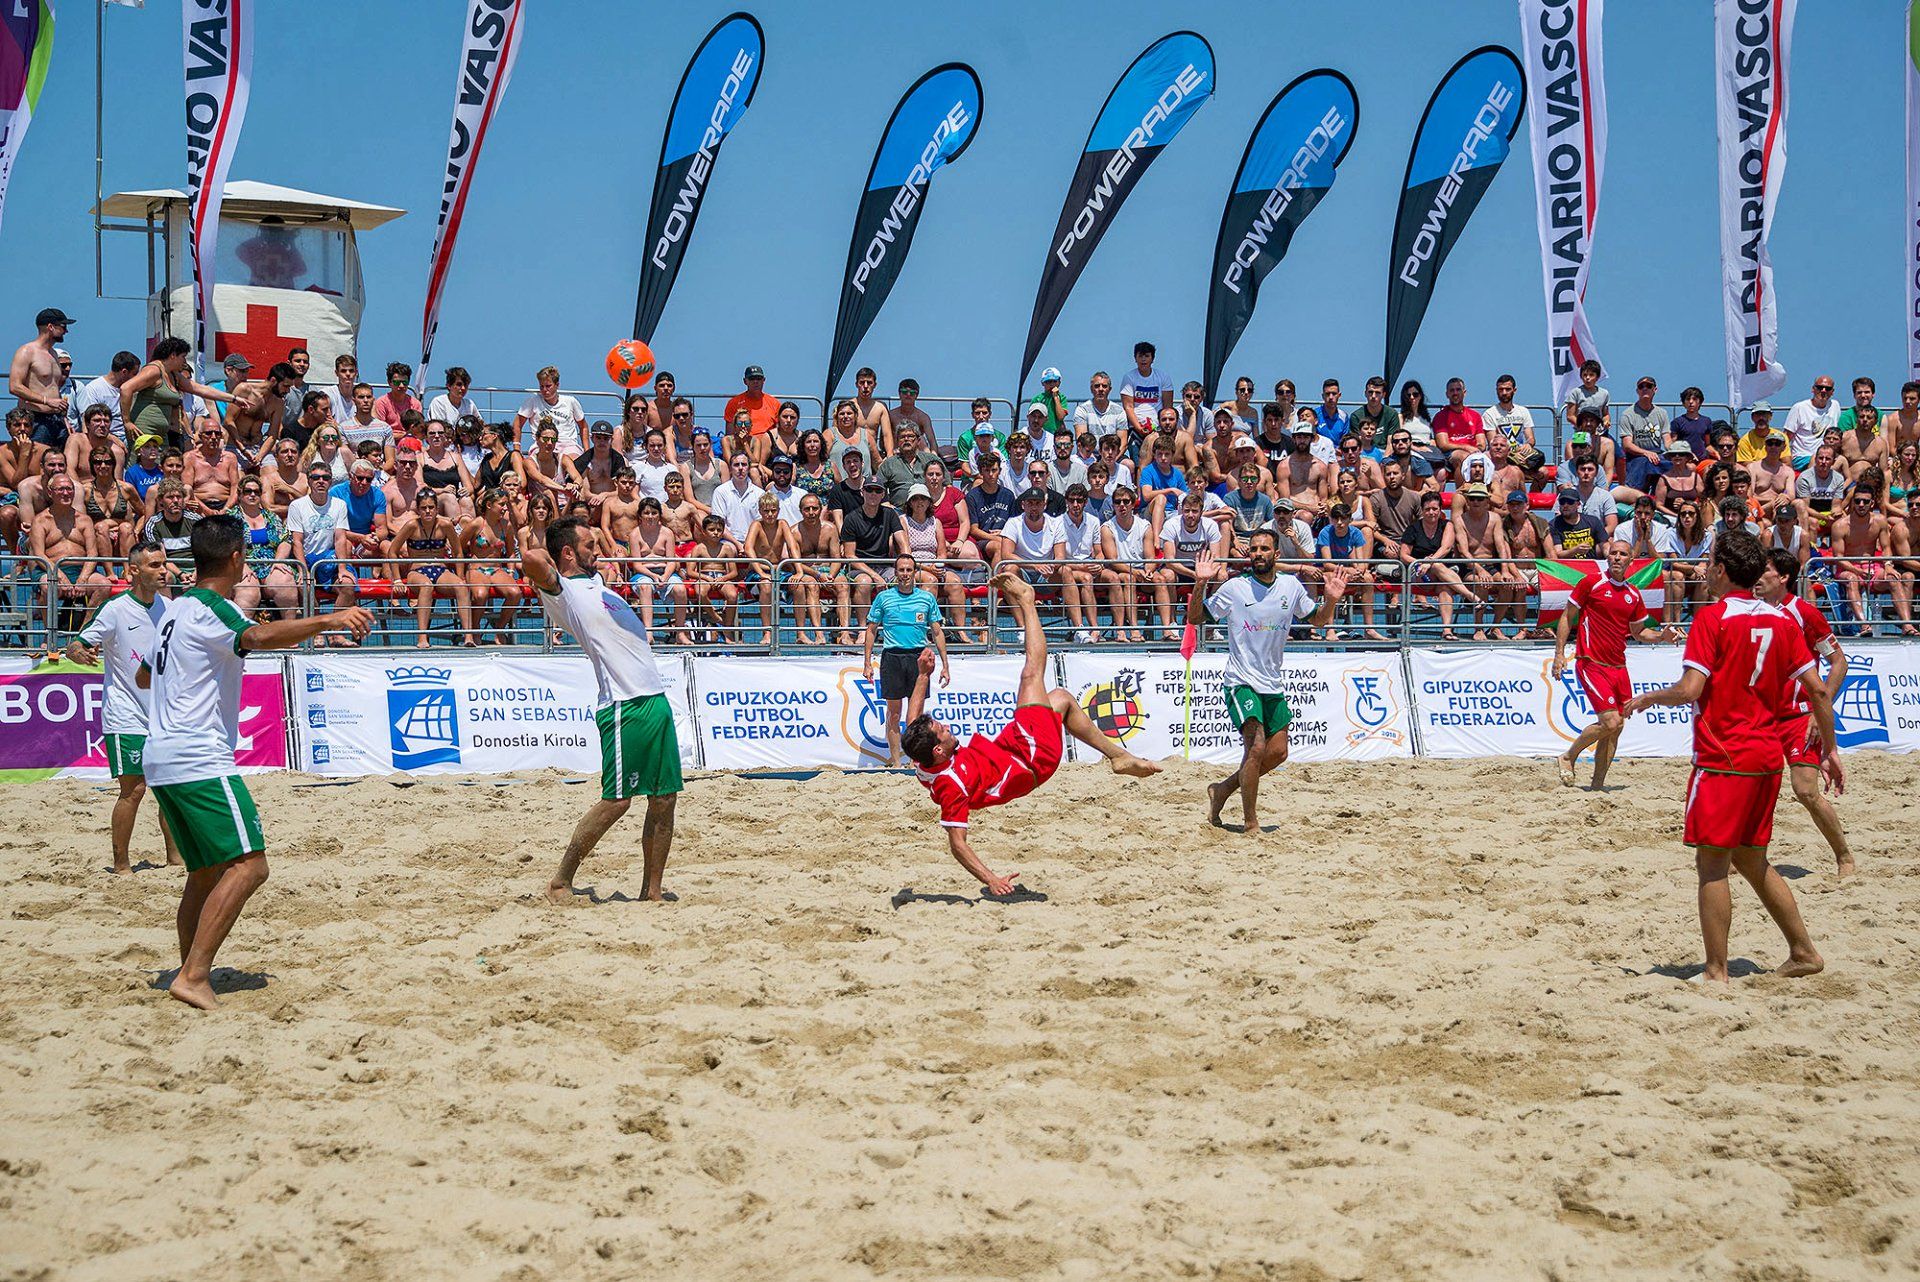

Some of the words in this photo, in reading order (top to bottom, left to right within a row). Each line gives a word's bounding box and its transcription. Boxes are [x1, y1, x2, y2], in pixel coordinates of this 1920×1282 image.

[1540, 0, 1580, 138] VASC
[652, 48, 753, 270] POWERADE
[1057, 63, 1204, 267] POWERADE
[1400, 80, 1513, 287] POWERADE
[852, 100, 970, 294] POWERADE
[1223, 105, 1345, 294] POWERADE
[1548, 143, 1585, 313] DIARIO
[156, 618, 177, 676] 3
[1748, 627, 1774, 687] 7
[1423, 679, 1533, 694] GIPUZKOAKO
[468, 688, 556, 702] DONOSTIA
[705, 690, 829, 706] GIPUZKOAKO
[1448, 696, 1513, 710] FUTBOL
[469, 708, 506, 722] SAN
[733, 708, 805, 723] FUTBOL
[1430, 712, 1536, 726] FEDERAZIOA
[1646, 712, 1667, 725] DE
[711, 723, 830, 740] FEDERAZIOA
[949, 723, 973, 736] DE
[473, 733, 539, 748] Donostia
[544, 733, 587, 747] Kirola
